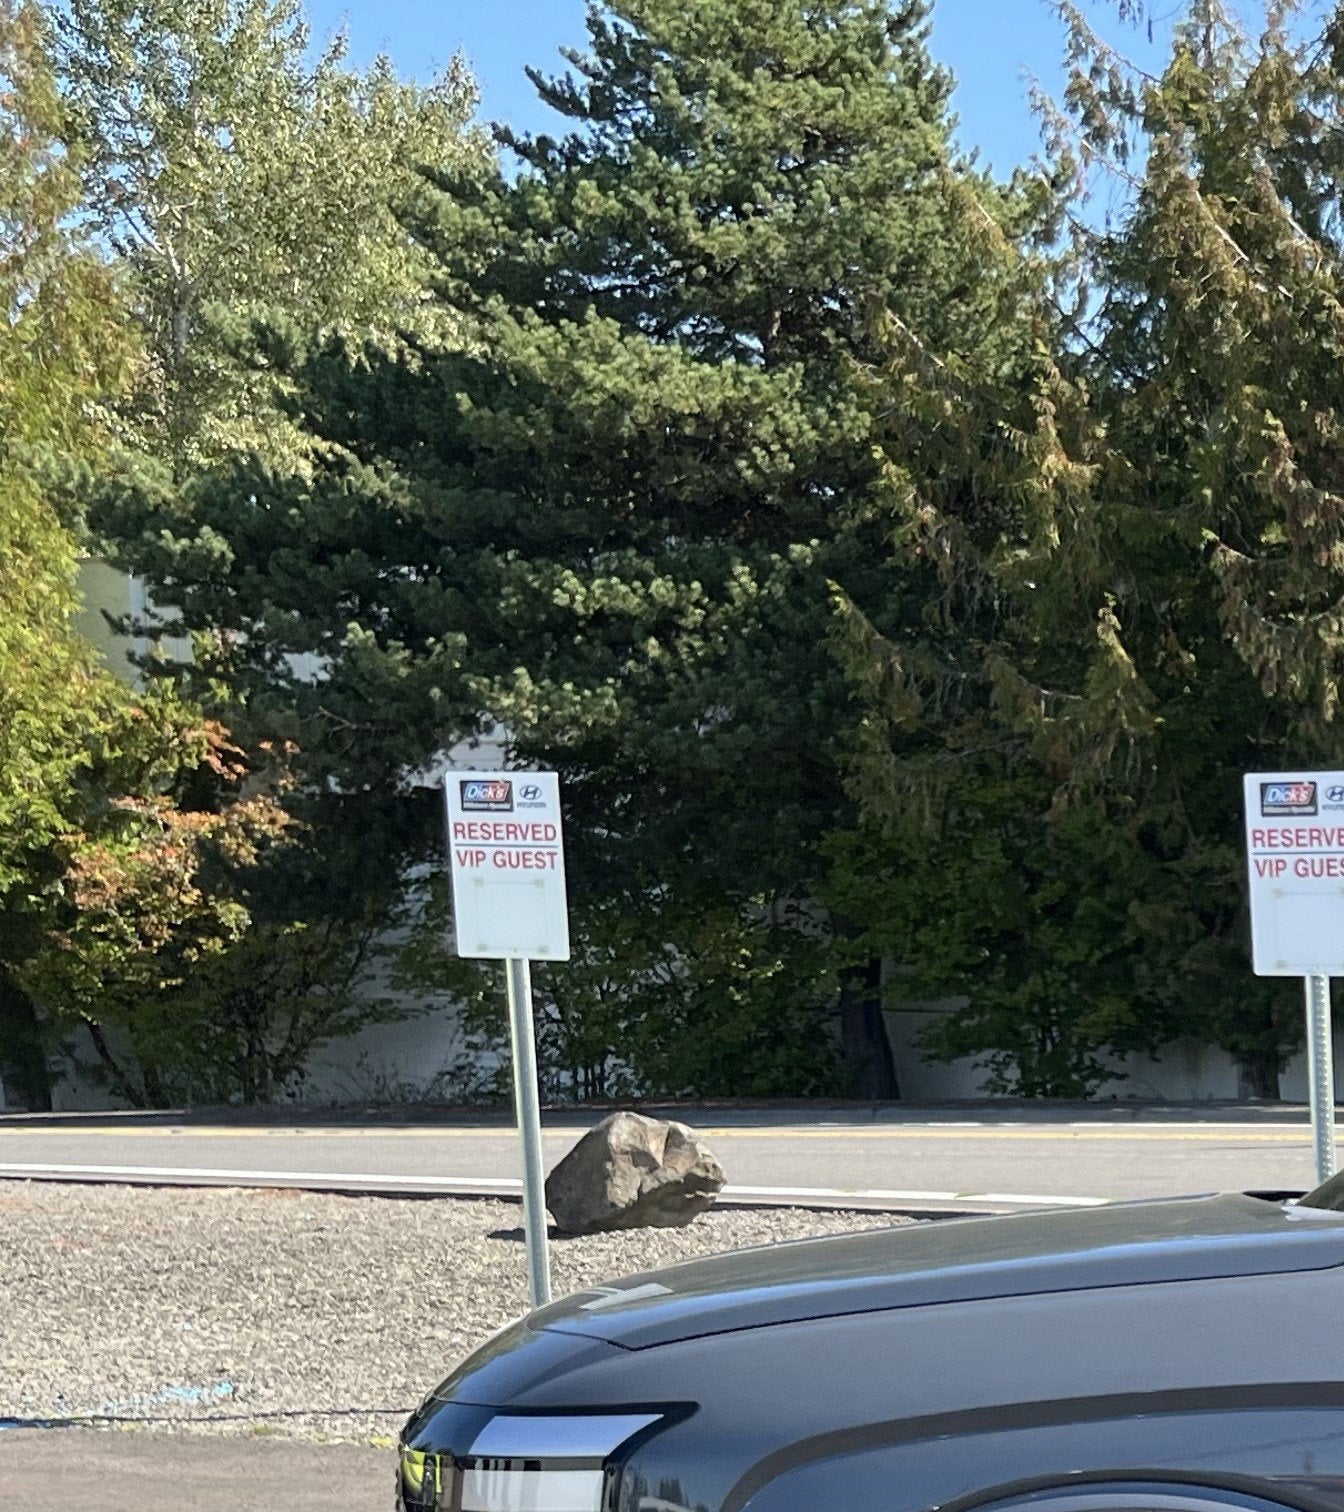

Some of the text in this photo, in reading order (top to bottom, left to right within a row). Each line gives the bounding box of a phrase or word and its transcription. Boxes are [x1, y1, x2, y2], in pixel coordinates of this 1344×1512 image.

[453, 822, 557, 841] RESERVED
[456, 850, 558, 870] VIP GUEST
[1254, 859, 1287, 878] VIP
